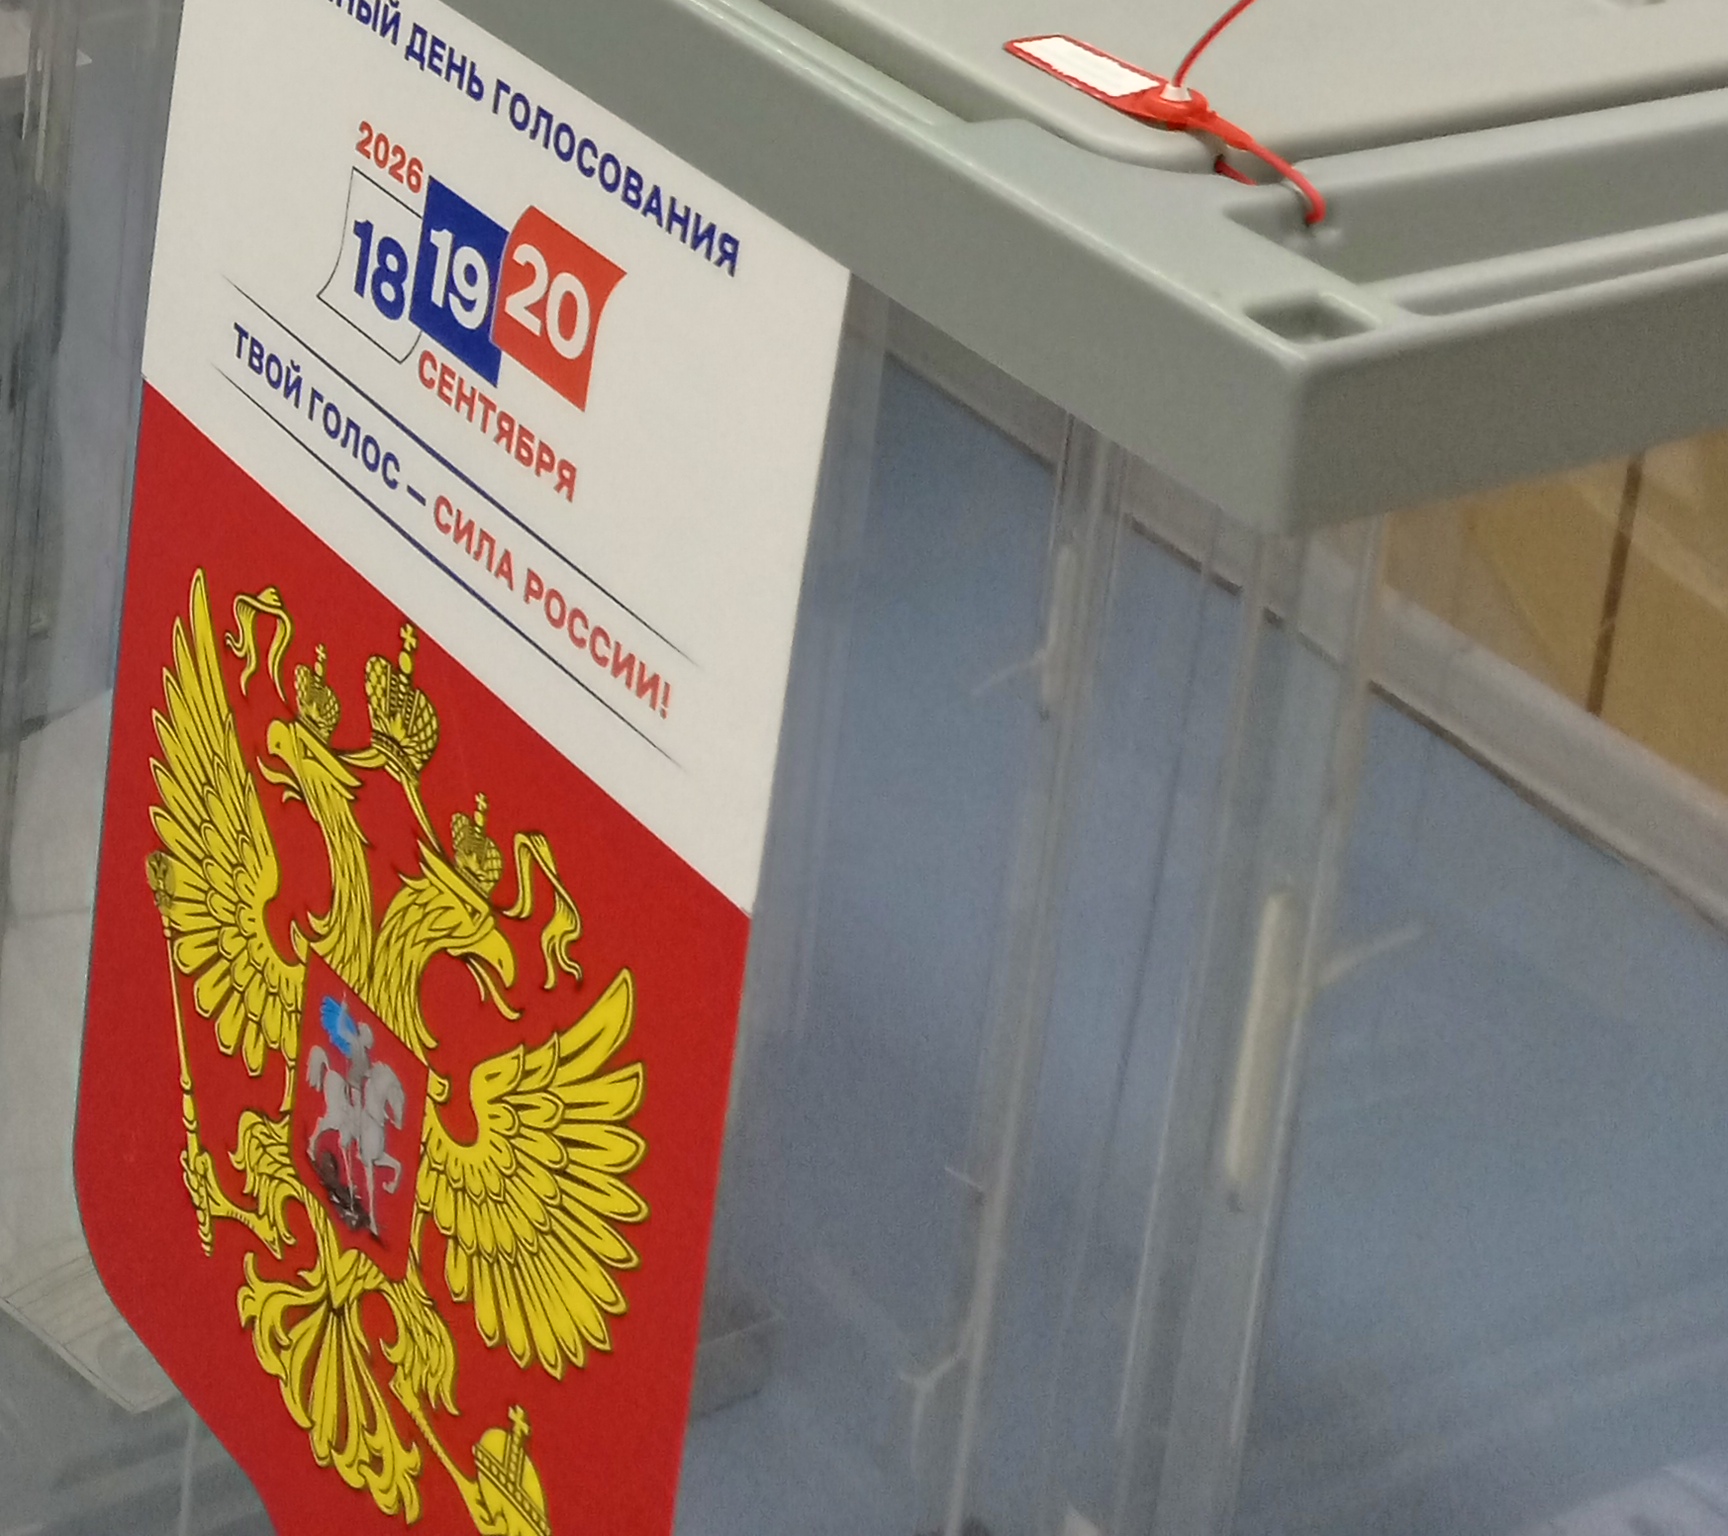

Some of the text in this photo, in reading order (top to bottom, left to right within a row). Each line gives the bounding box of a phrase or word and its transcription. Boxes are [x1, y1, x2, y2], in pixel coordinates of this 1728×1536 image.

[356, 120, 424, 194] 2026
[404, 23, 484, 104] ДЕНЬ
[492, 78, 742, 278] ГОЛОСОВАНИЯ
[353, 219, 592, 363] 18 19 20
[417, 348, 578, 503] СЕНТЯБРЯ
[232, 322, 302, 410] ТВОЙ
[307, 395, 400, 492] ГОЛОС
[433, 494, 515, 592] СИЛА
[525, 568, 672, 720] РОССИИ!
